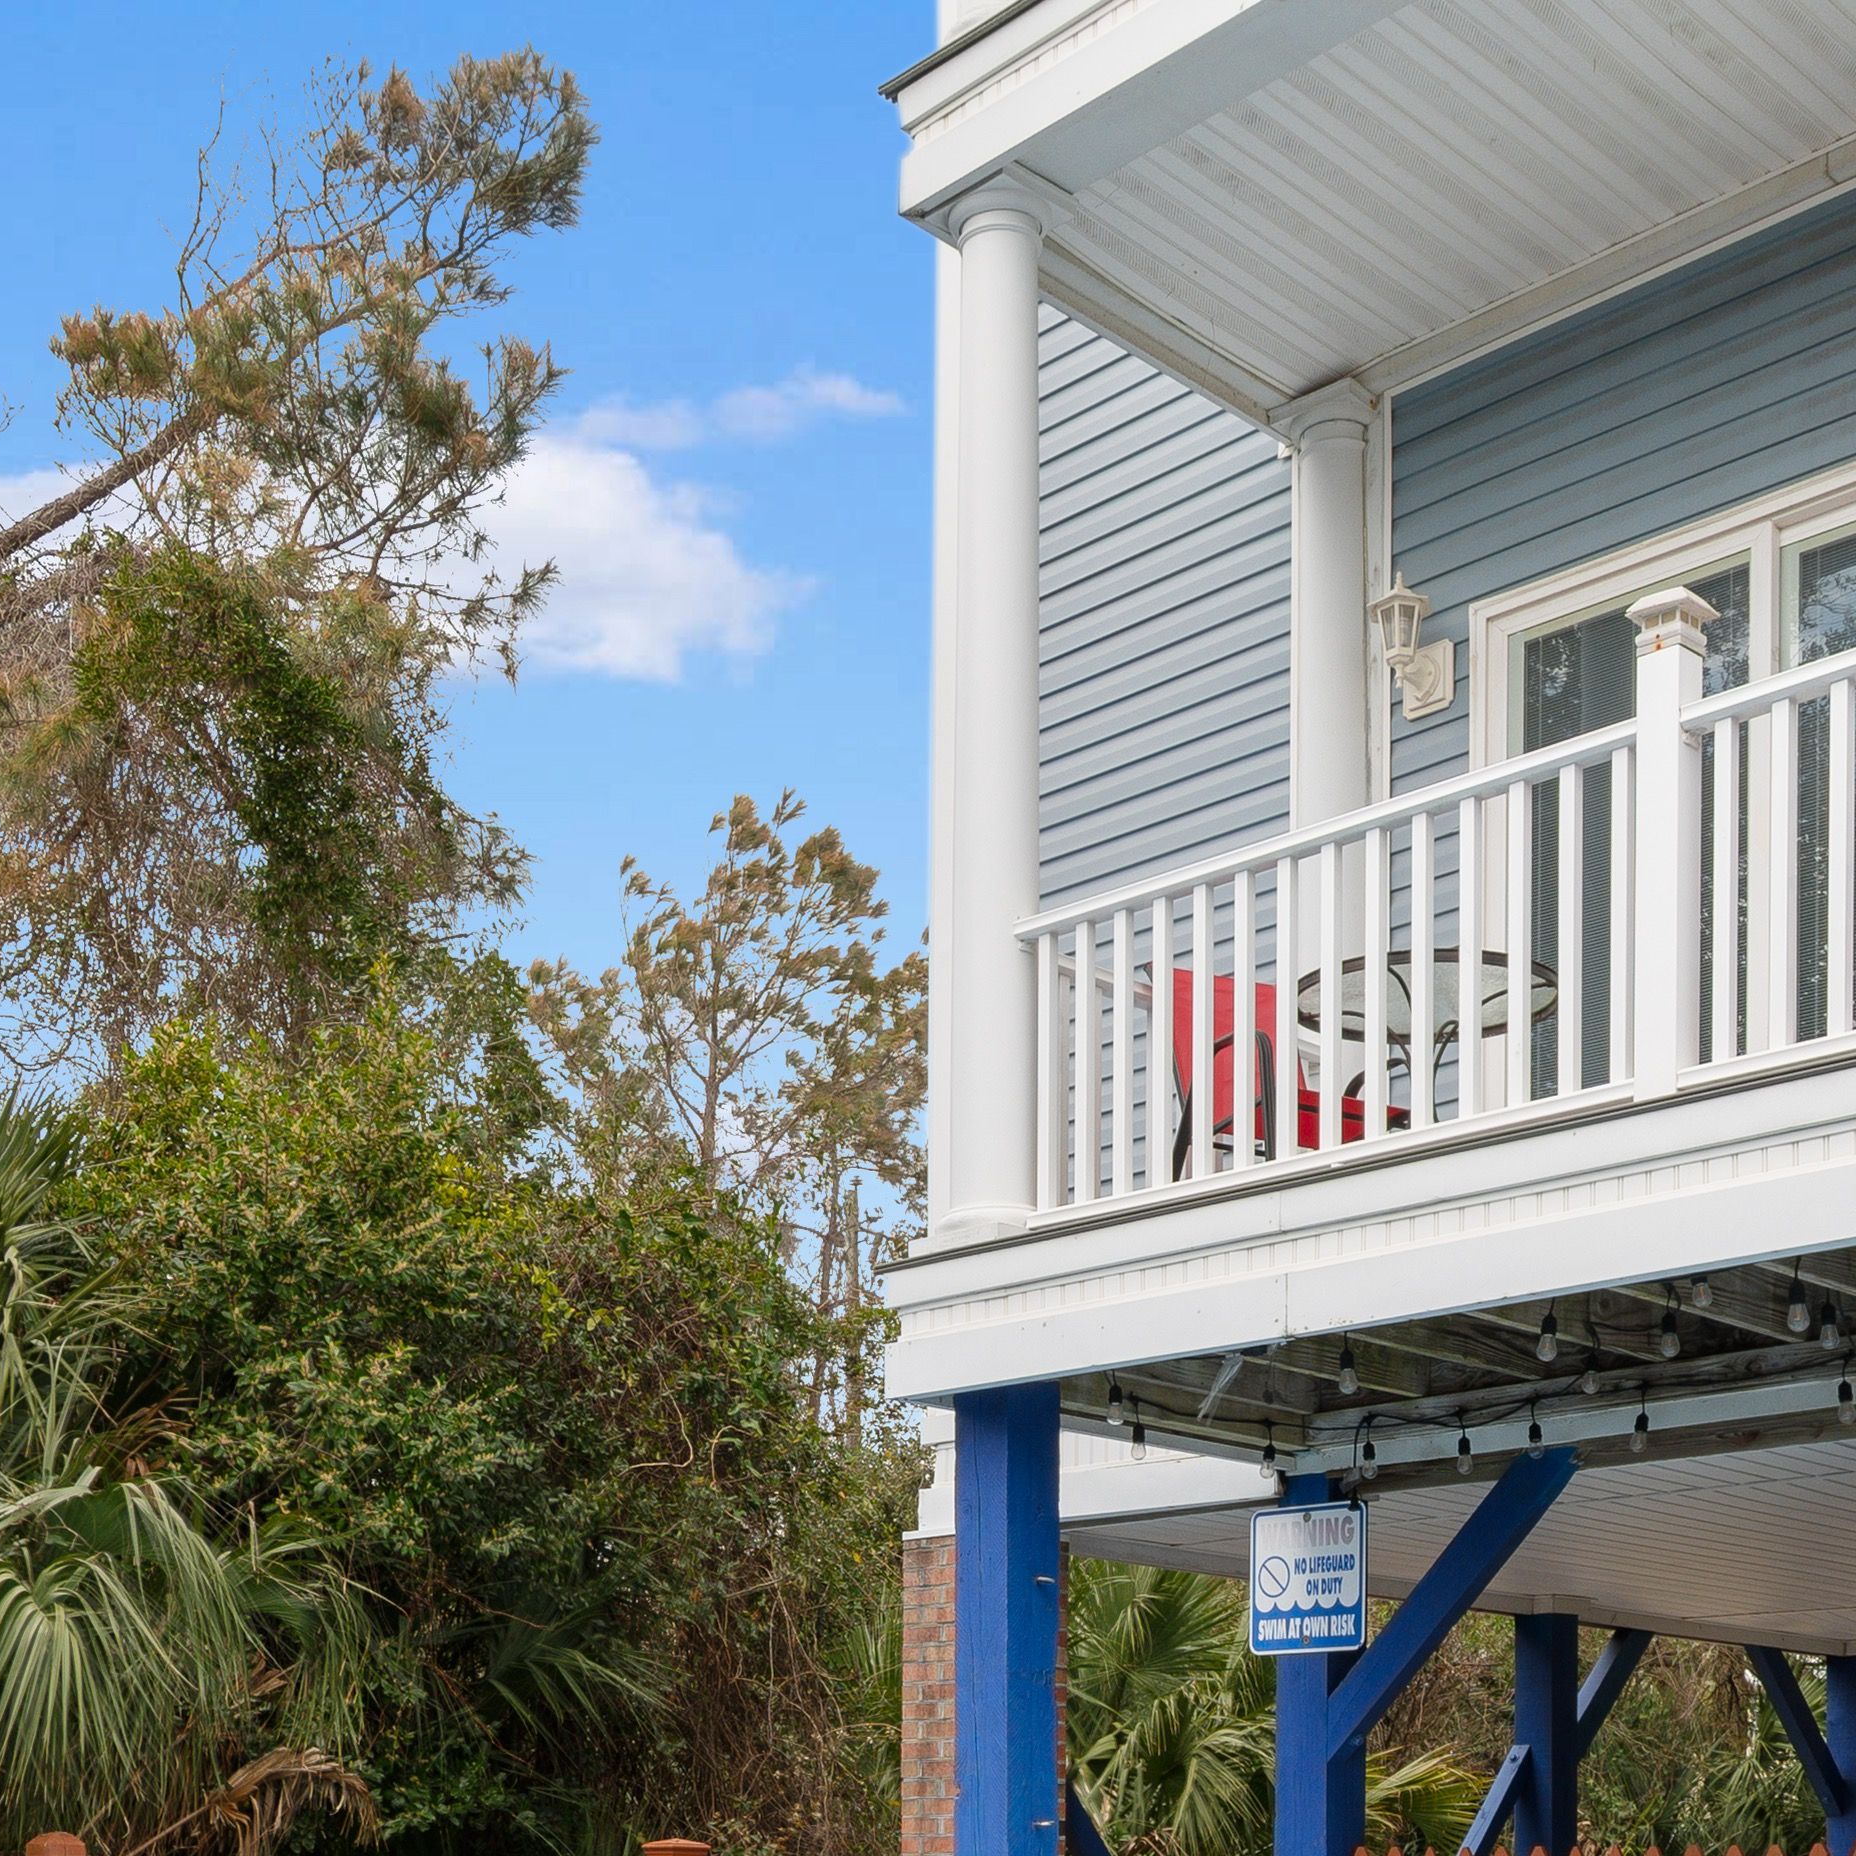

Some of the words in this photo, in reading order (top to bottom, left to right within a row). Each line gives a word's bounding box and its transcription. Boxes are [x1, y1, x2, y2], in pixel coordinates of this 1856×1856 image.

[1260, 1516, 1355, 1551] WARNING
[1294, 1557, 1307, 1576] NO
[1308, 1553, 1356, 1573] LIFEGUARD
[1306, 1579, 1319, 1596] ON
[1321, 1577, 1344, 1595] DUTY
[1258, 1618, 1287, 1641] SWIM
[1288, 1617, 1302, 1639] AT
[1302, 1615, 1329, 1639] OWN
[1330, 1614, 1356, 1637] RISK
